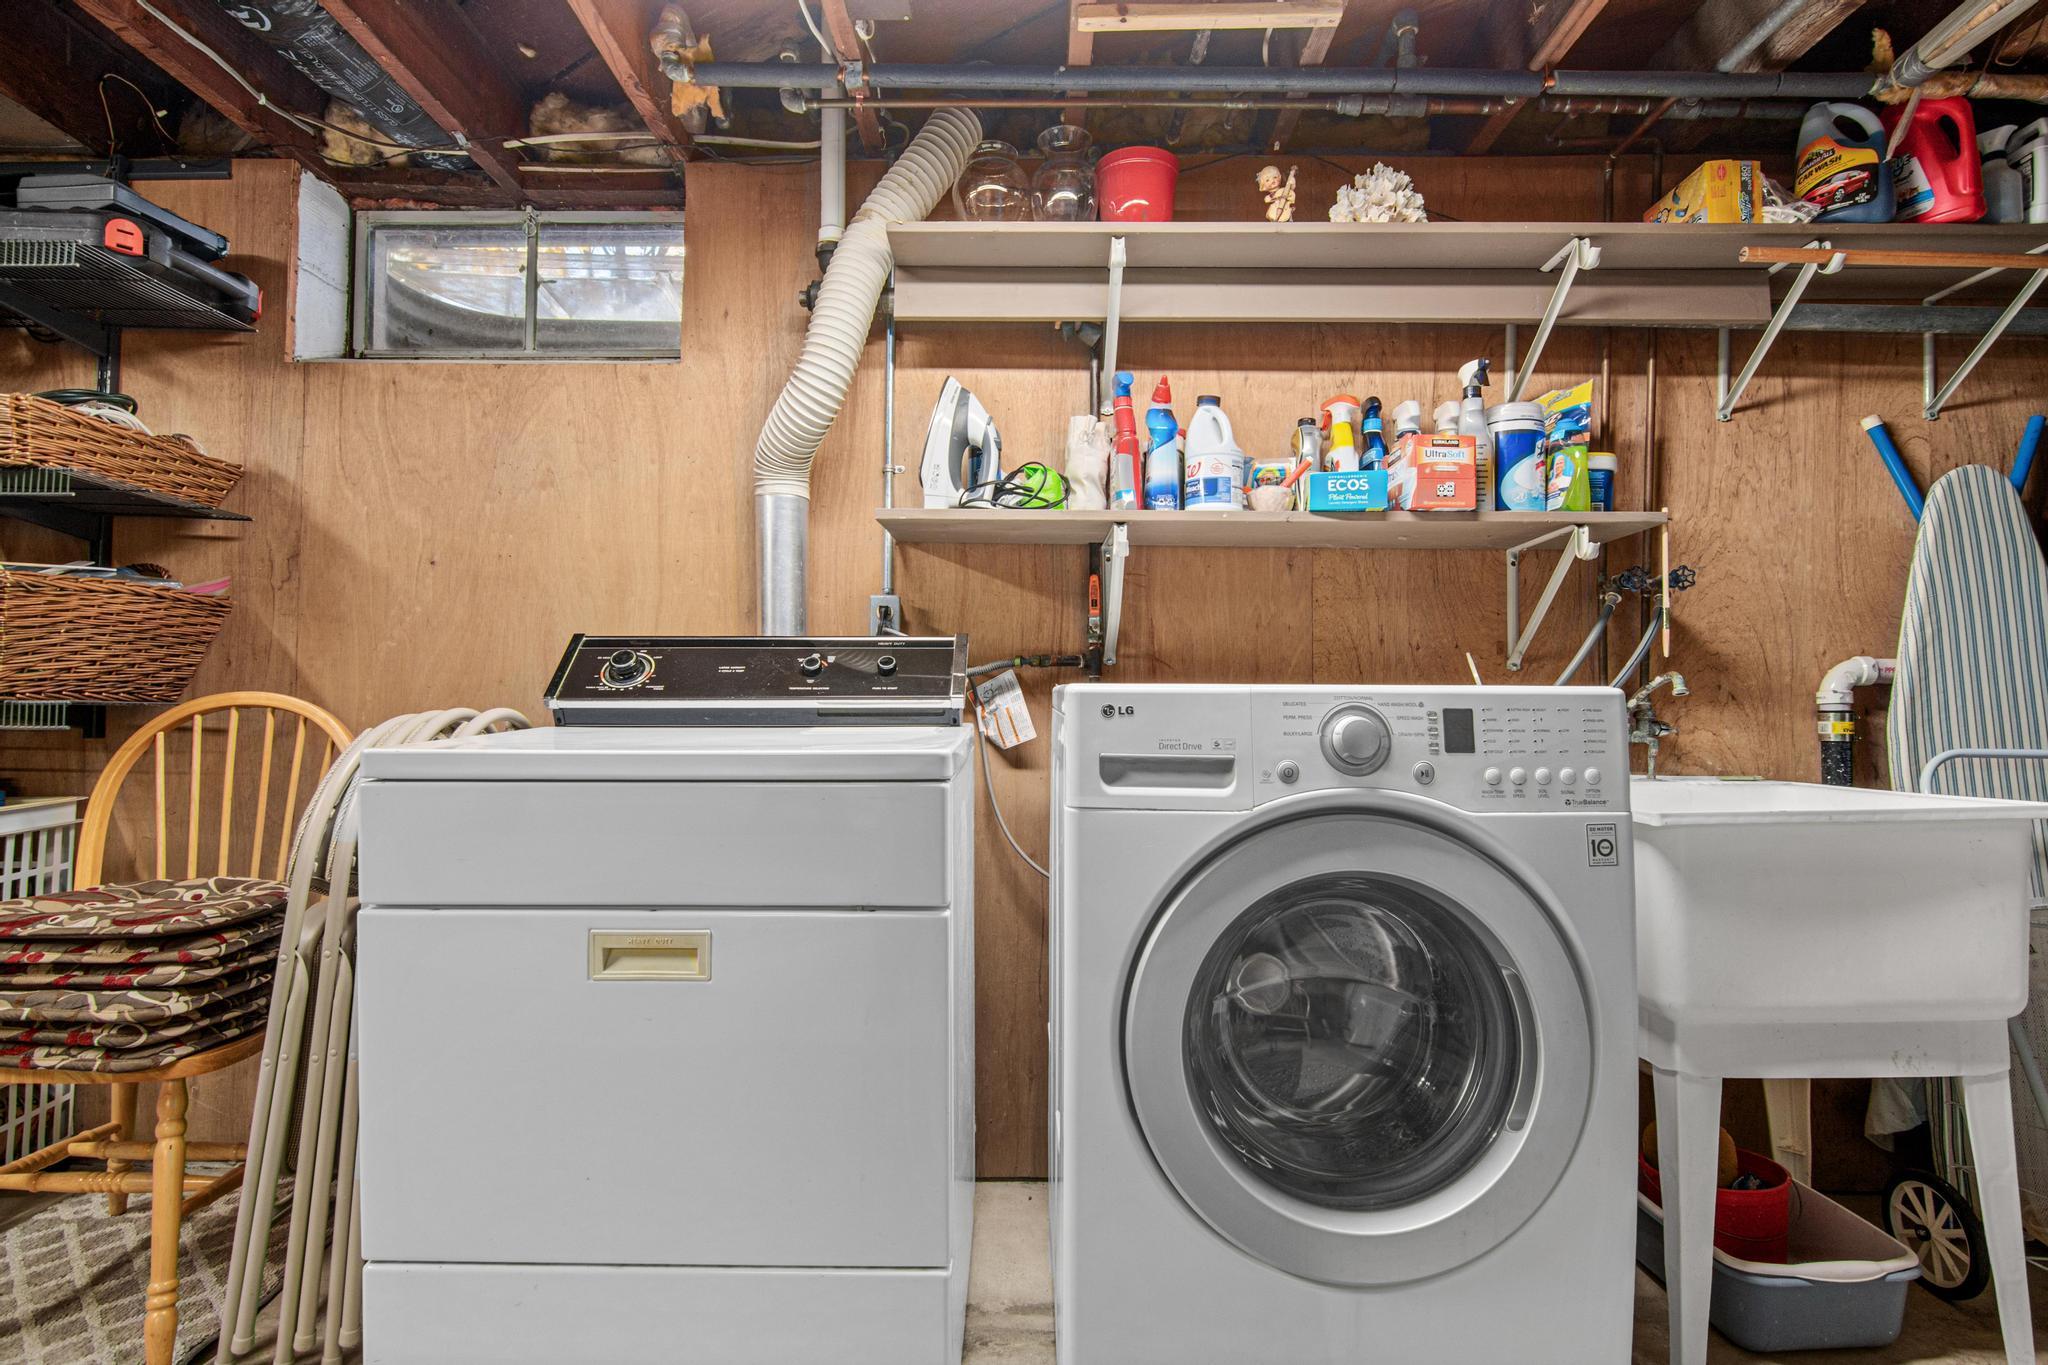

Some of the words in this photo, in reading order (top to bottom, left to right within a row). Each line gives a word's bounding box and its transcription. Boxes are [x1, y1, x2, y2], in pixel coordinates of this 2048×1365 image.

[1798, 171, 1813, 185] CAR
[1814, 154, 1843, 173] WASH
[1327, 478, 1370, 492] ECOS
[1118, 705, 1134, 715] LG
[1158, 742, 1181, 751] Direct
[1182, 742, 1202, 751] Drive
[1591, 838, 1614, 857] 10
